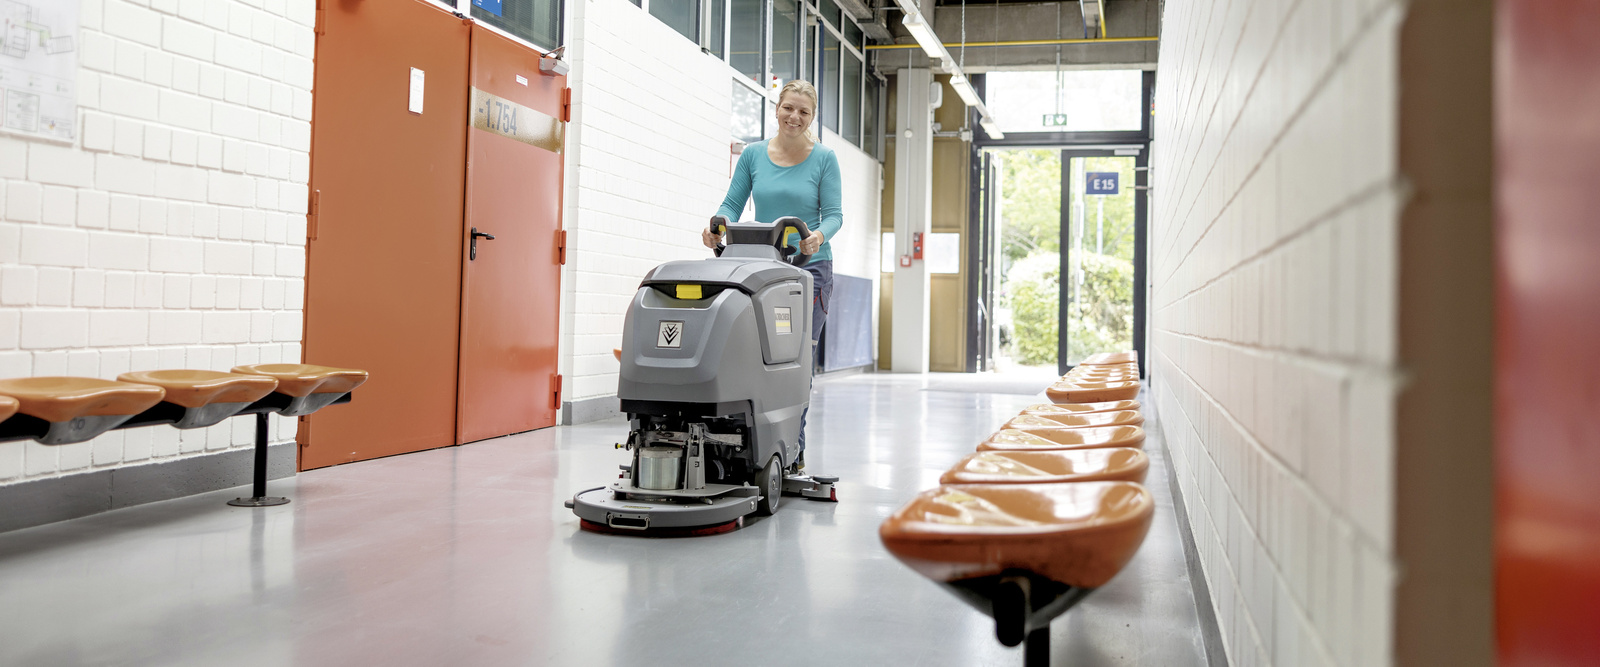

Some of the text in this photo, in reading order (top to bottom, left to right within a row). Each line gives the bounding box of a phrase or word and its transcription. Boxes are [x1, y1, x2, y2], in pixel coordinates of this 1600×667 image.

[479, 98, 517, 135] -1.754
[1093, 179, 1115, 190] E 15
